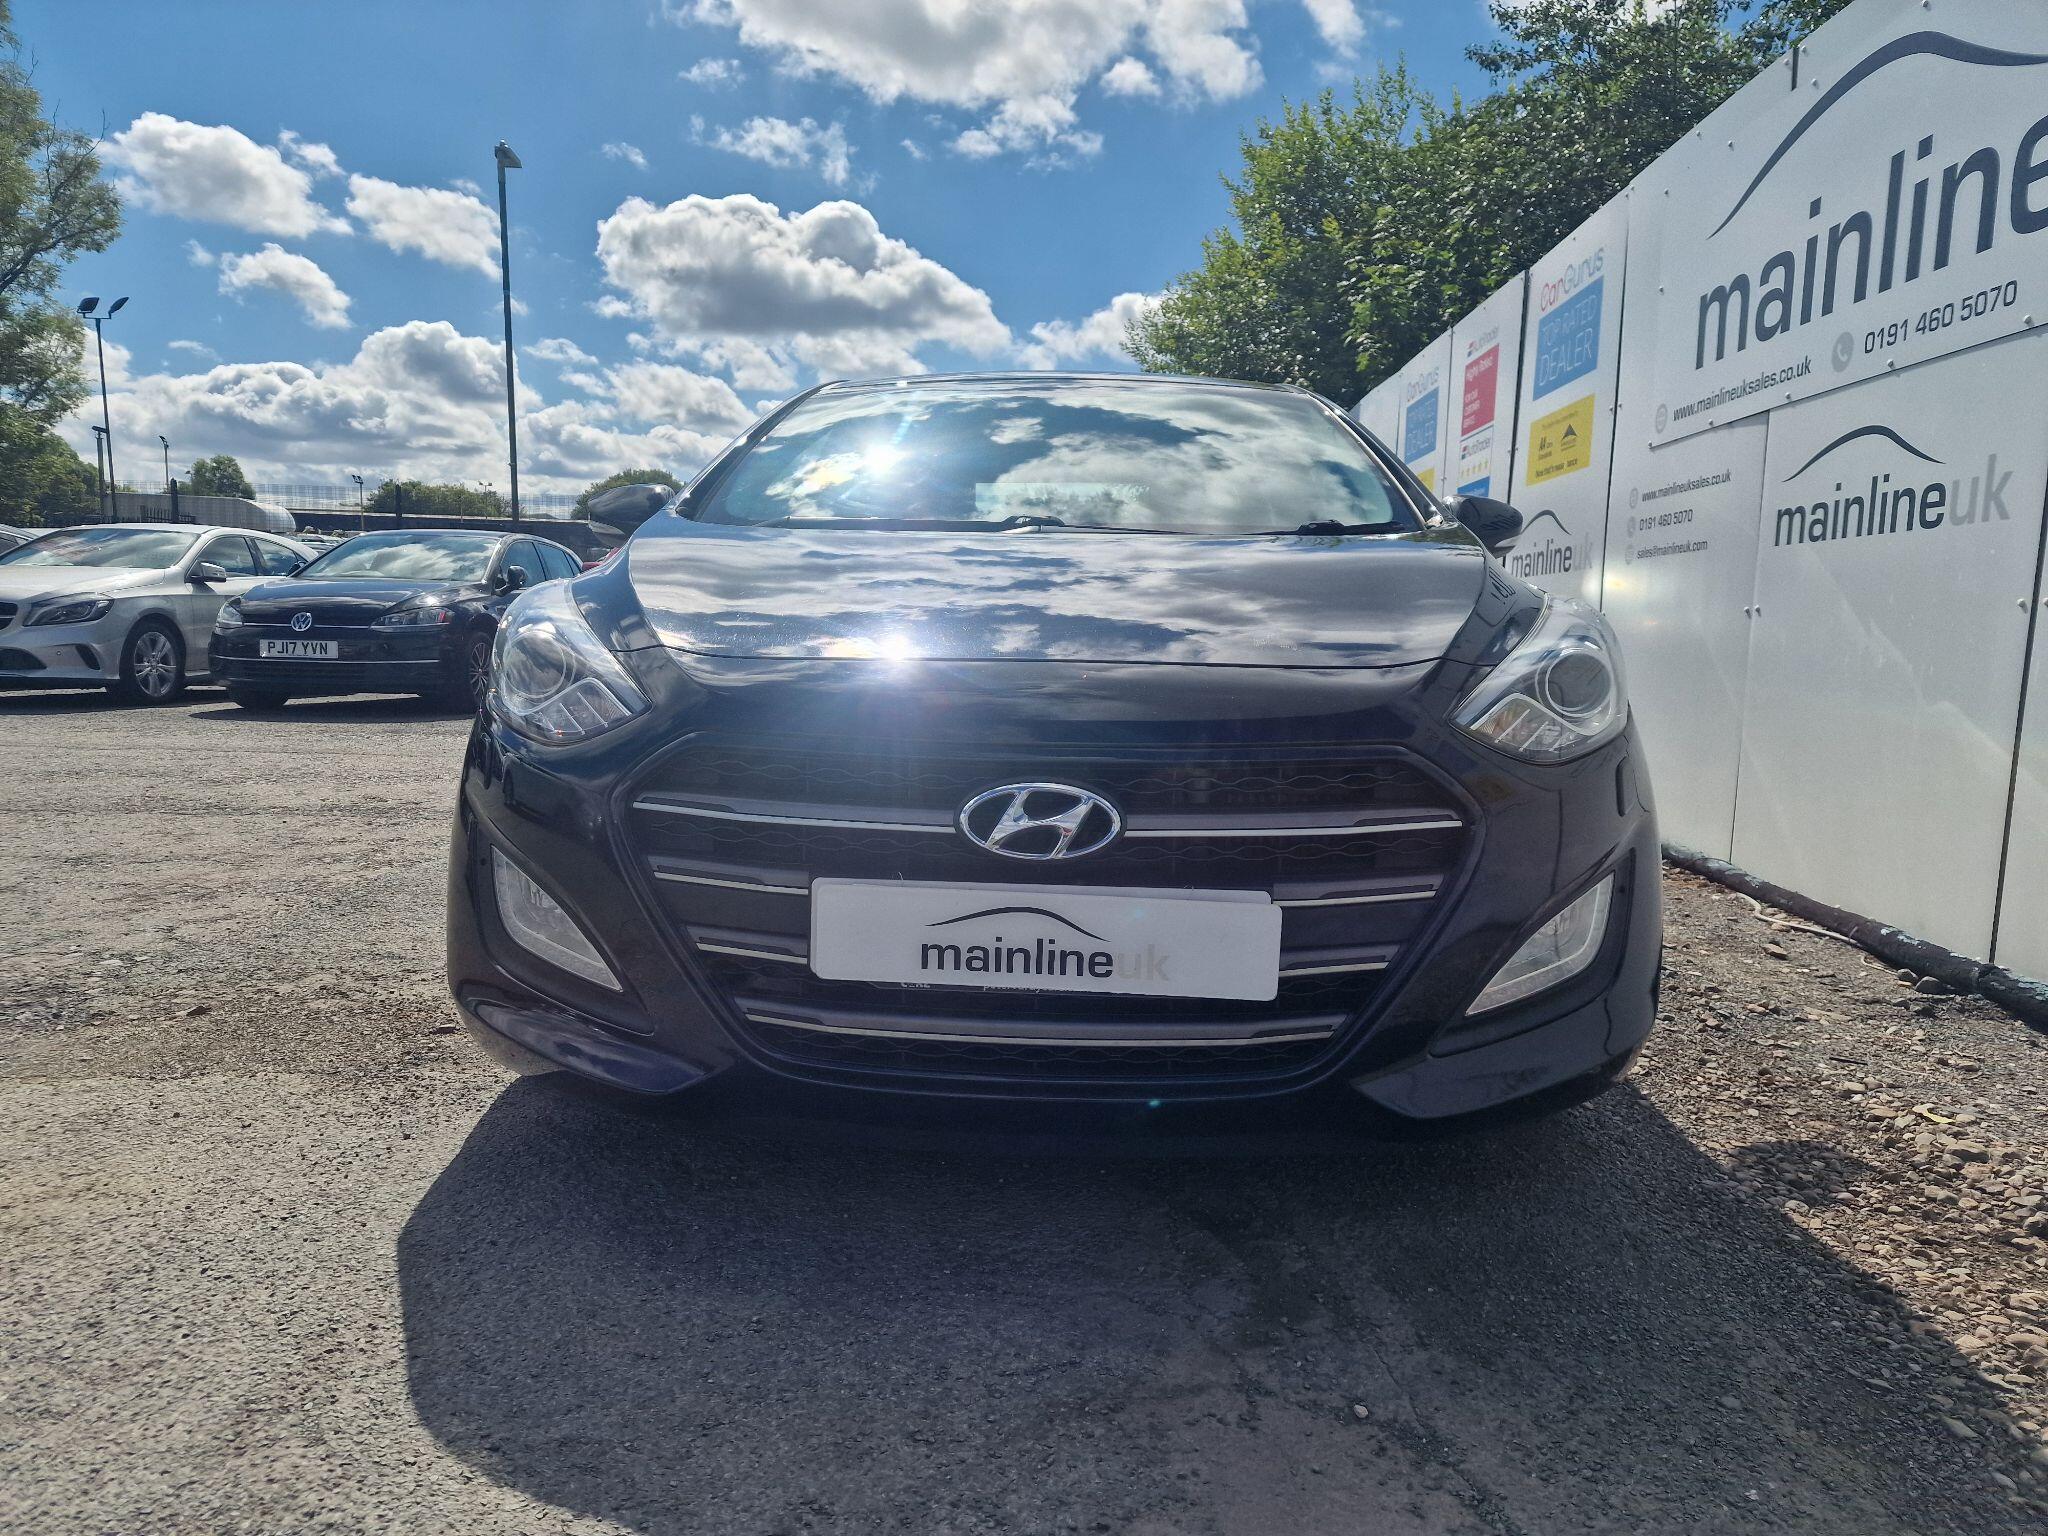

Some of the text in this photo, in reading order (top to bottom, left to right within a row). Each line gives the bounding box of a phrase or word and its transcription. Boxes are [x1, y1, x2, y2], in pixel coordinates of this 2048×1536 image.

[1540, 247, 1604, 312] CarGurus
[1864, 279, 2018, 355] 0191 460 5070
[1538, 327, 1593, 386] DEALER
[1673, 356, 1812, 423] www.mainlineuksales.co.uk
[1642, 468, 1731, 502] www.mainlineuksales.co.uk
[1774, 453, 2014, 547] mainlineuk
[1639, 508, 1694, 531] 0191 460 5070
[1637, 540, 1708, 560] sales@mainlineuk.com
[267, 641, 328, 655] PJ17 YVN
[920, 936, 1170, 982] mainlineuk
